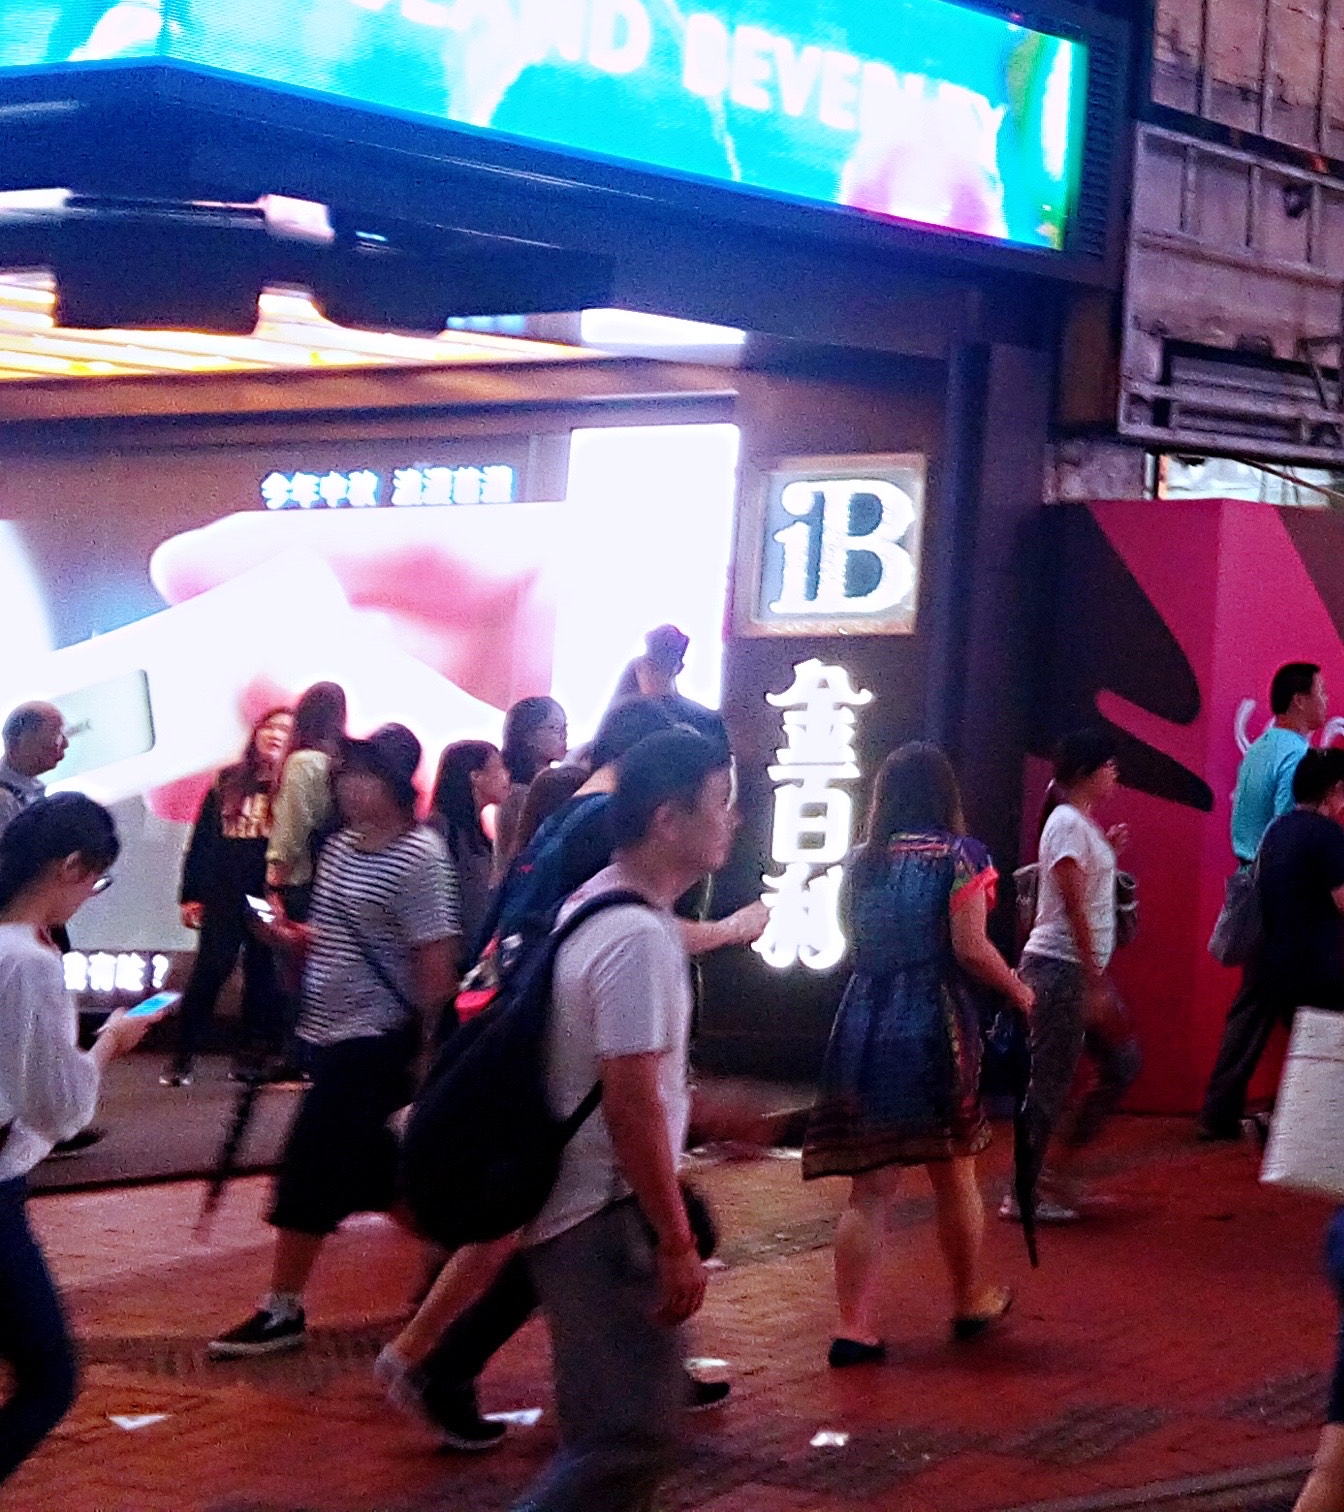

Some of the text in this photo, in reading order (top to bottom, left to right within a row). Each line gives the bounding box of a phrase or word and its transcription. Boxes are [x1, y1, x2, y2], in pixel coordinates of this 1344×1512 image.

[769, 479, 916, 614] iB
[760, 658, 871, 969] 金百利
